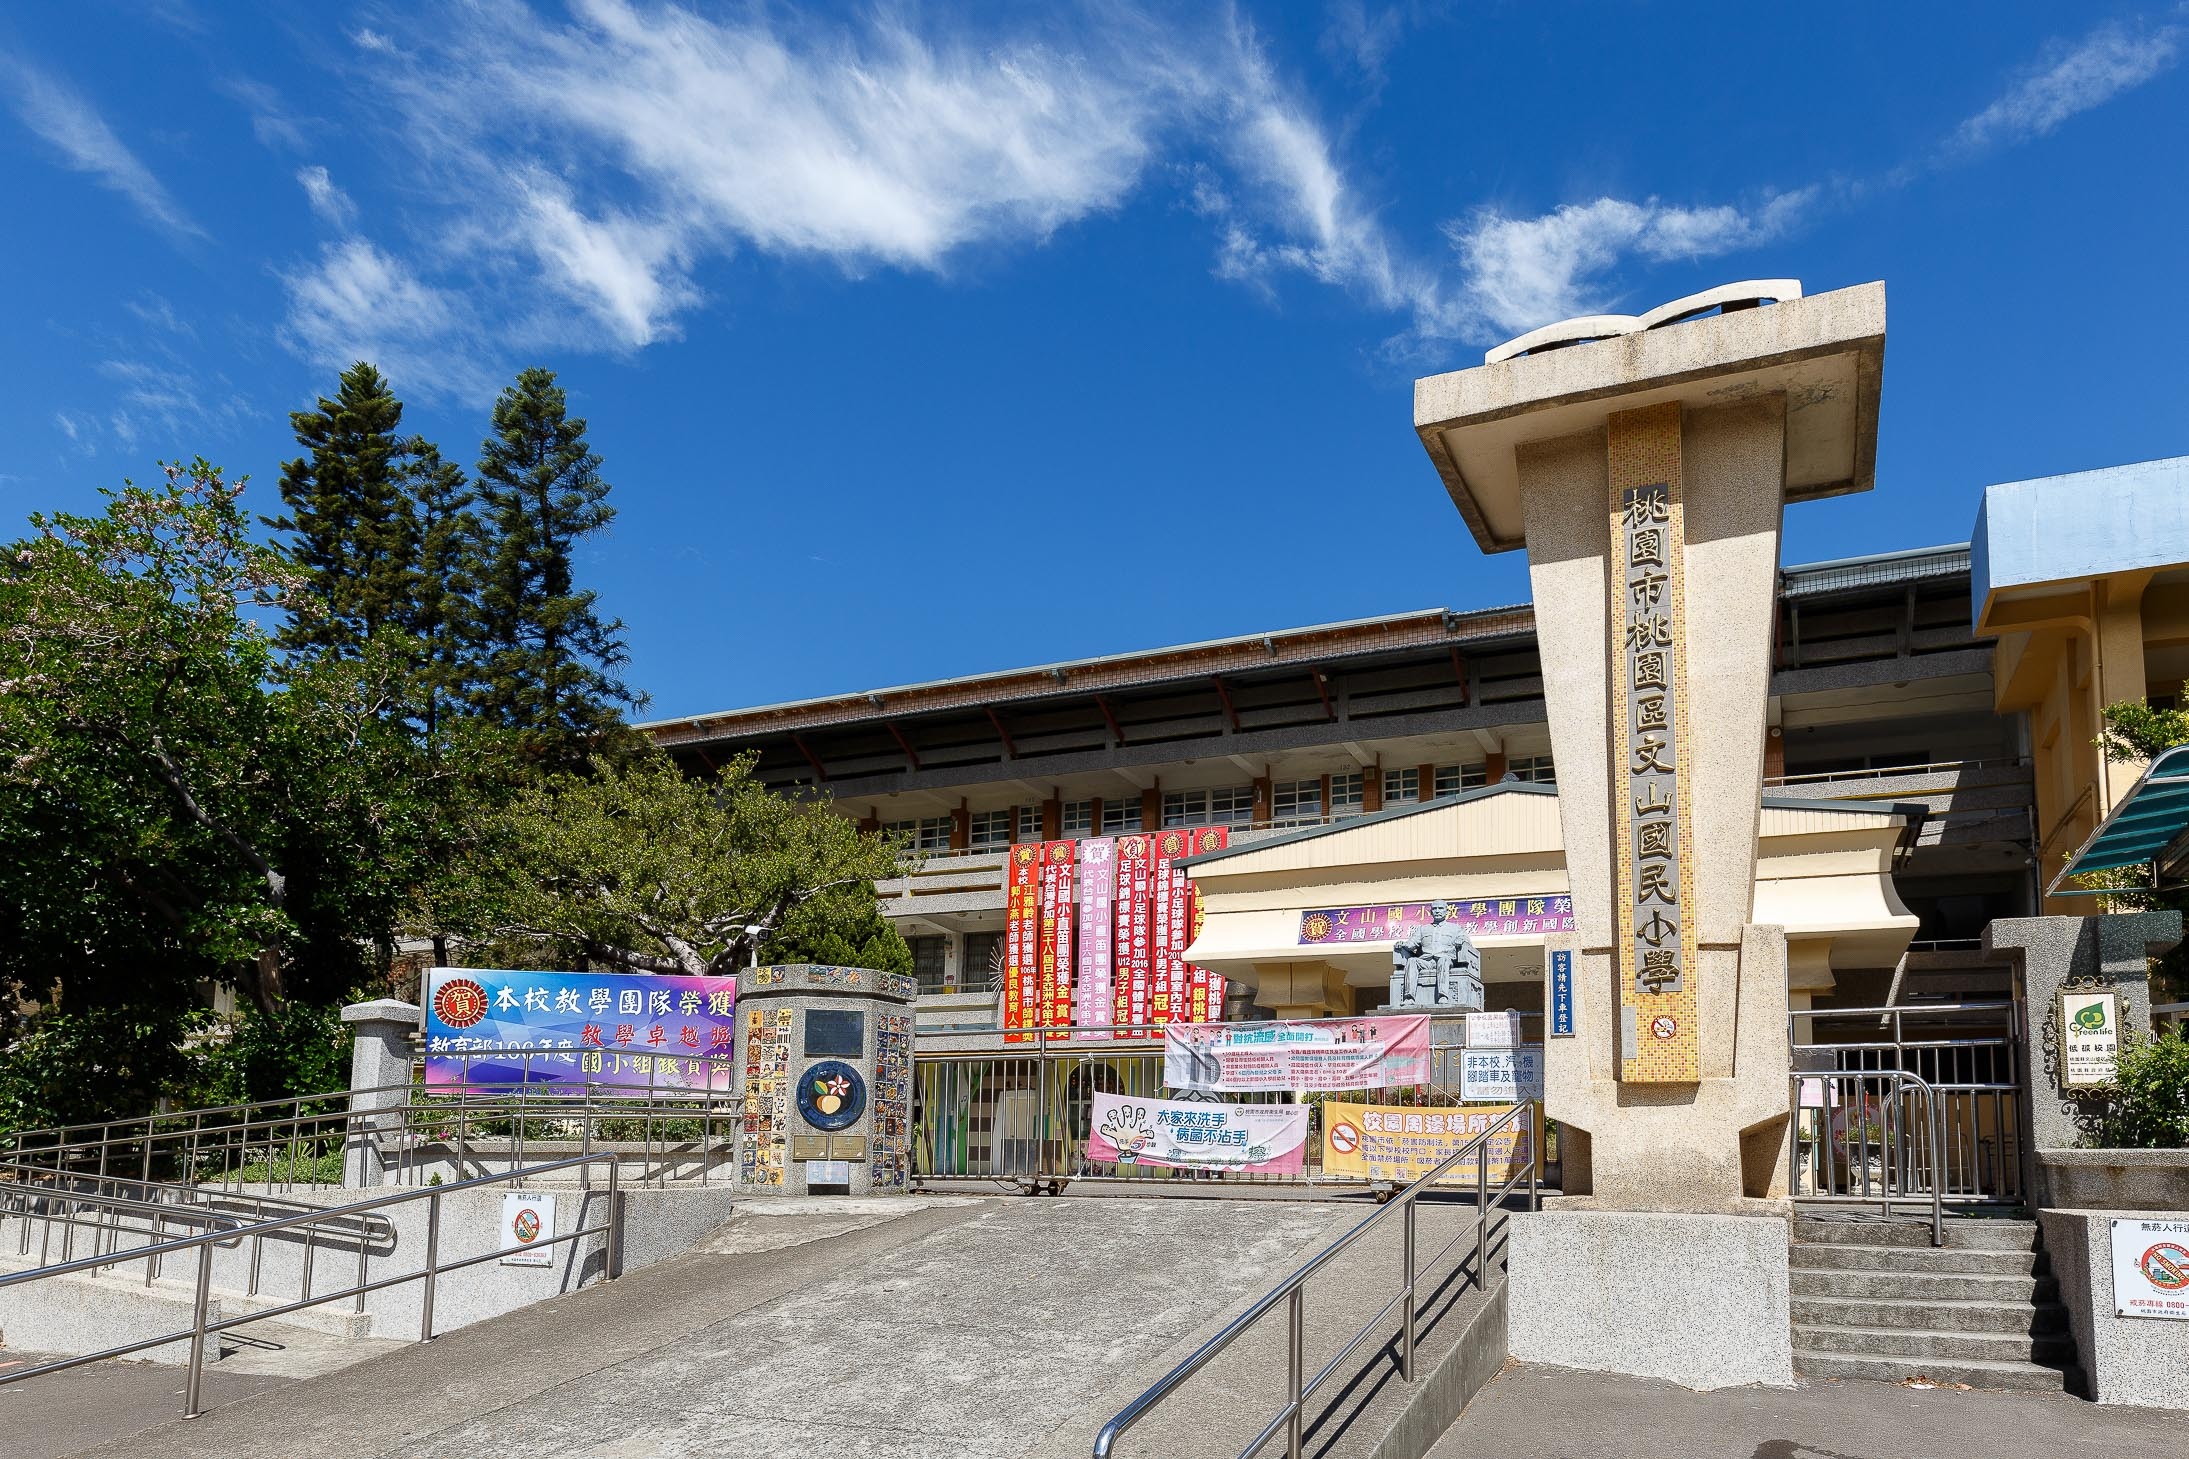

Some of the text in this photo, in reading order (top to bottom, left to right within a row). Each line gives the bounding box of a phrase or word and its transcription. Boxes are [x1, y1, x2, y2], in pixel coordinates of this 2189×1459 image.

[1622, 488, 1680, 996] 桃園市桃園區文山國民小學
[1124, 840, 1141, 859] 賀
[1018, 868, 1029, 885] 本校
[451, 989, 471, 1017] 賀
[493, 985, 734, 1018] 本校教學團隊榮獲
[580, 1023, 732, 1049] 教學卓越獎
[1233, 1030, 1275, 1044] 對抗流感
[1157, 1110, 1227, 1128] 大家來洗手
[1176, 1128, 1248, 1147] 病菌不沾手
[2161, 1259, 2186, 1280] SMOKING
